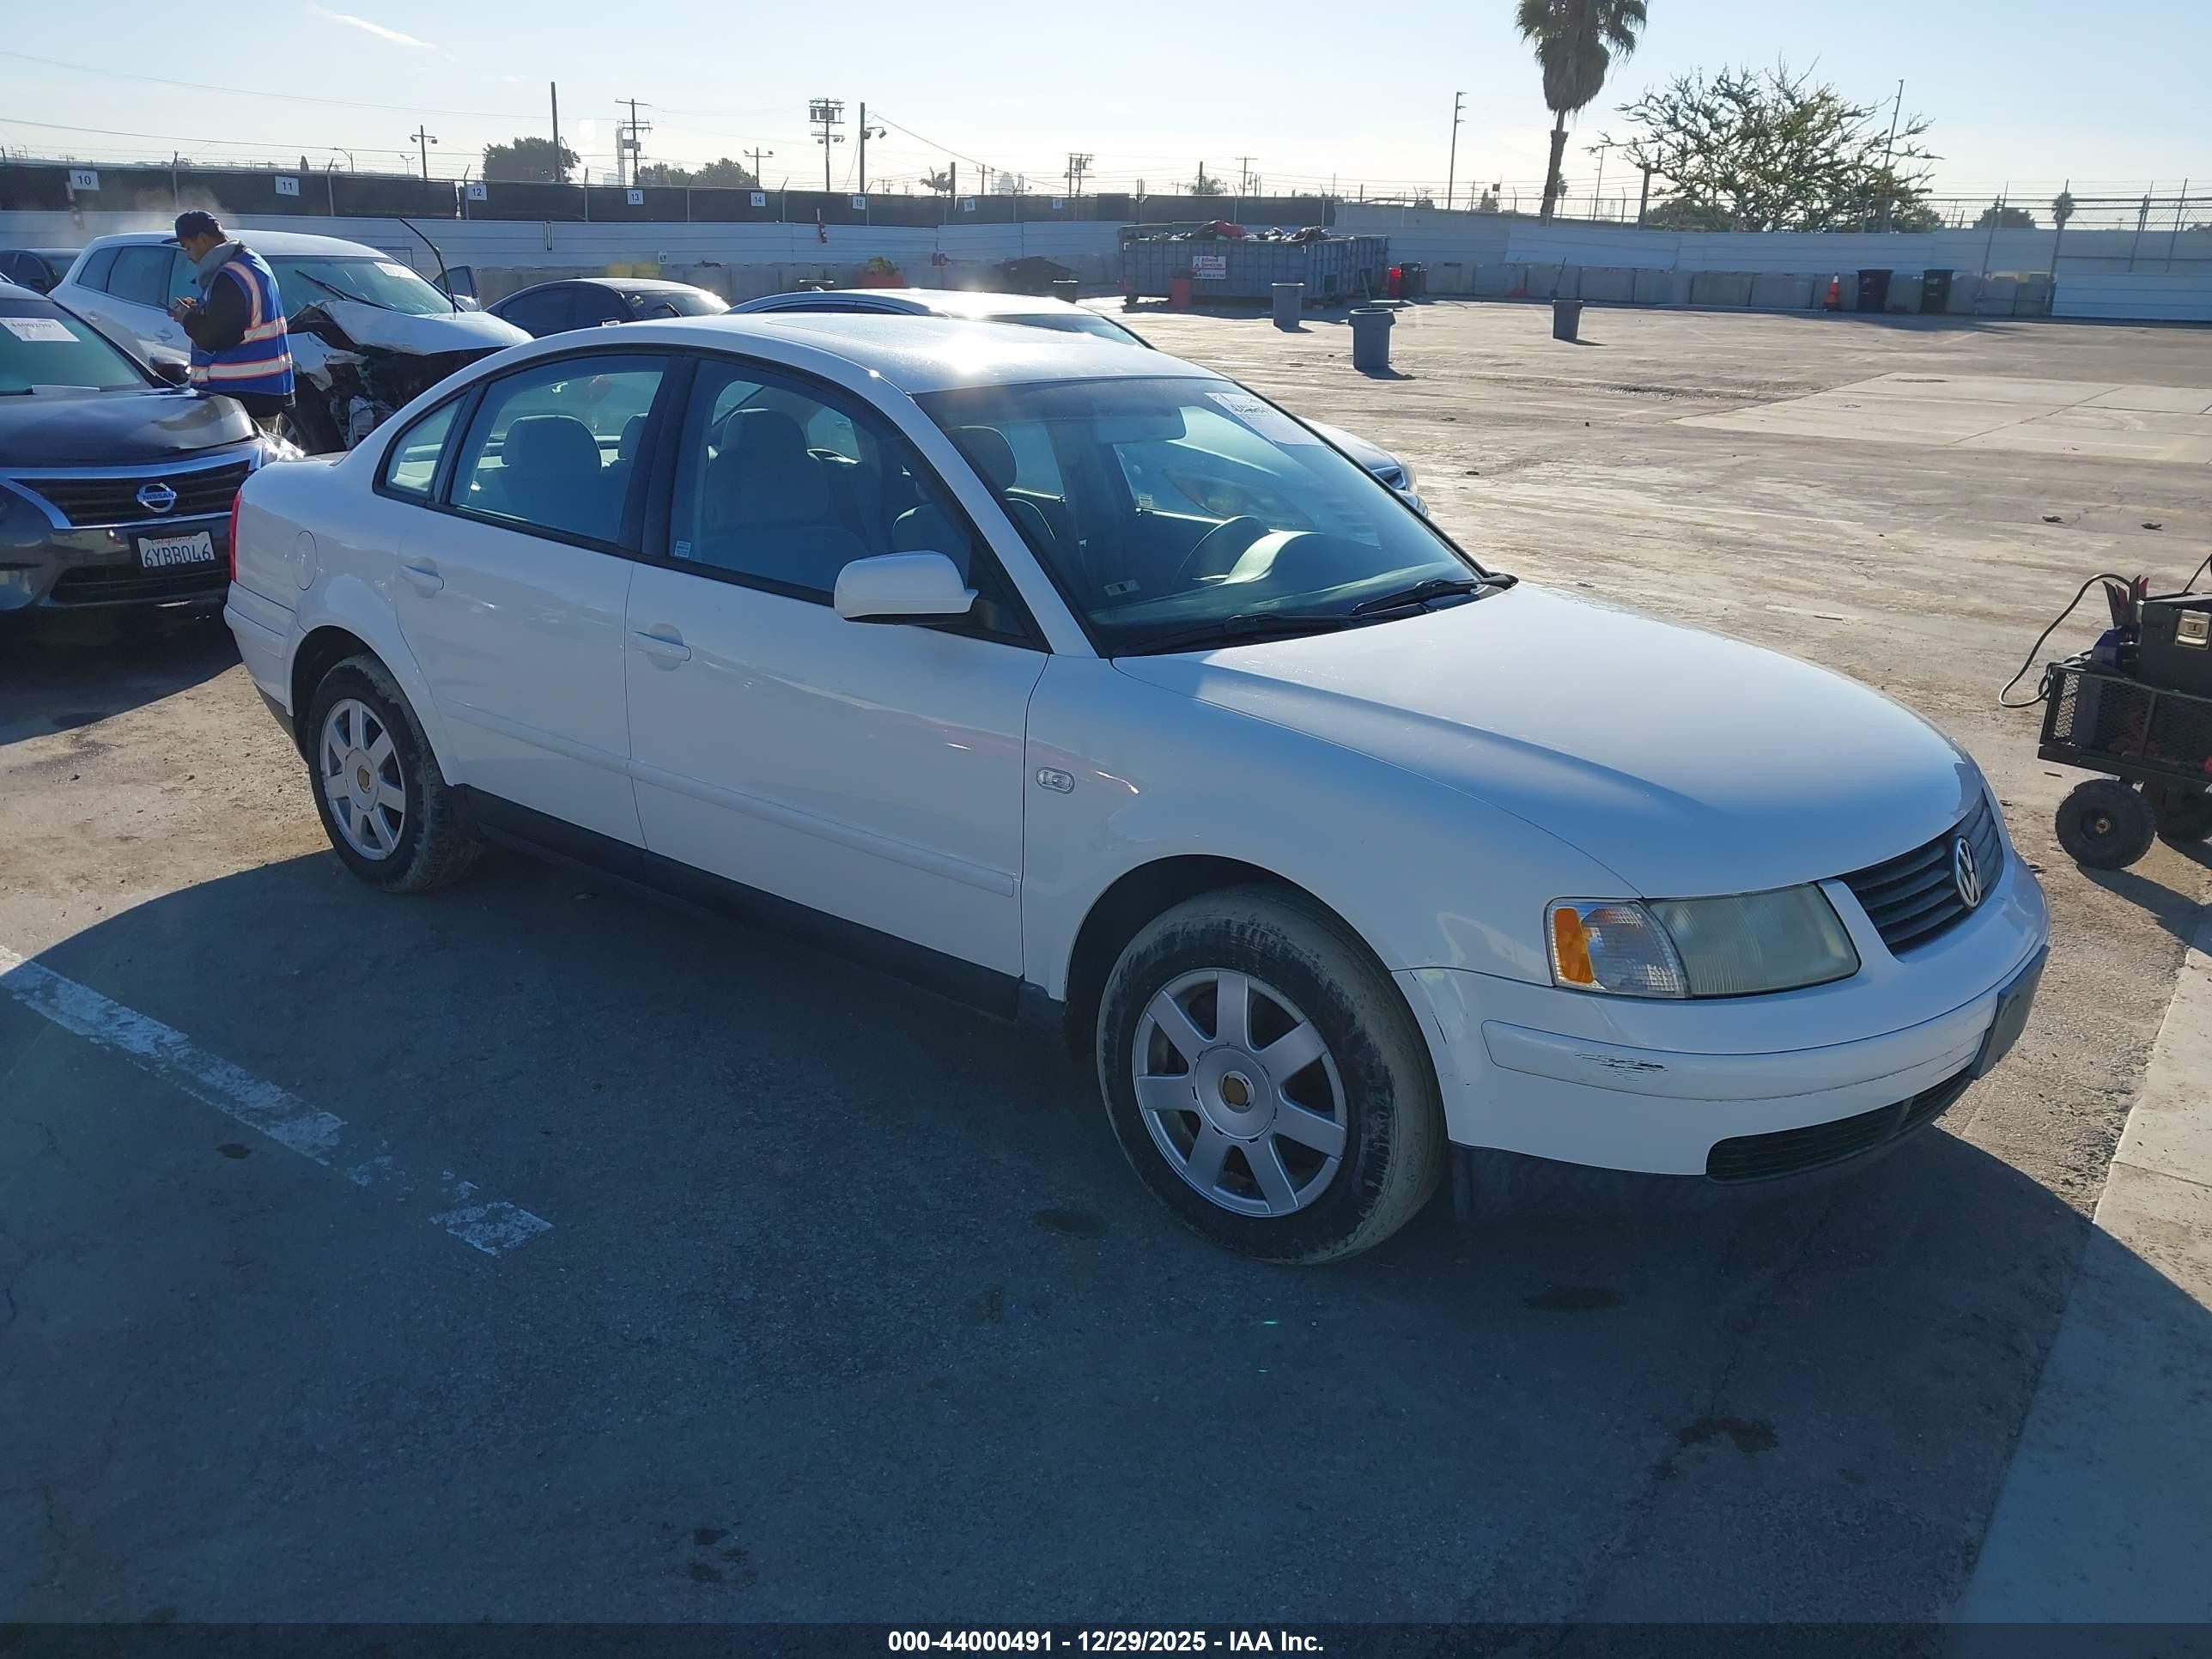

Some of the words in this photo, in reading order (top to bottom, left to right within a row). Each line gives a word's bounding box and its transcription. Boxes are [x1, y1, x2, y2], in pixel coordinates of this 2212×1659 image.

[77, 175, 91, 185] 10
[283, 181, 292, 191] 11
[472, 188, 482, 197] 12
[632, 192, 640, 201] 13
[856, 198, 863, 207] 15
[143, 492, 175, 501] NISSAN
[144, 543, 212, 568] 6YBB046
